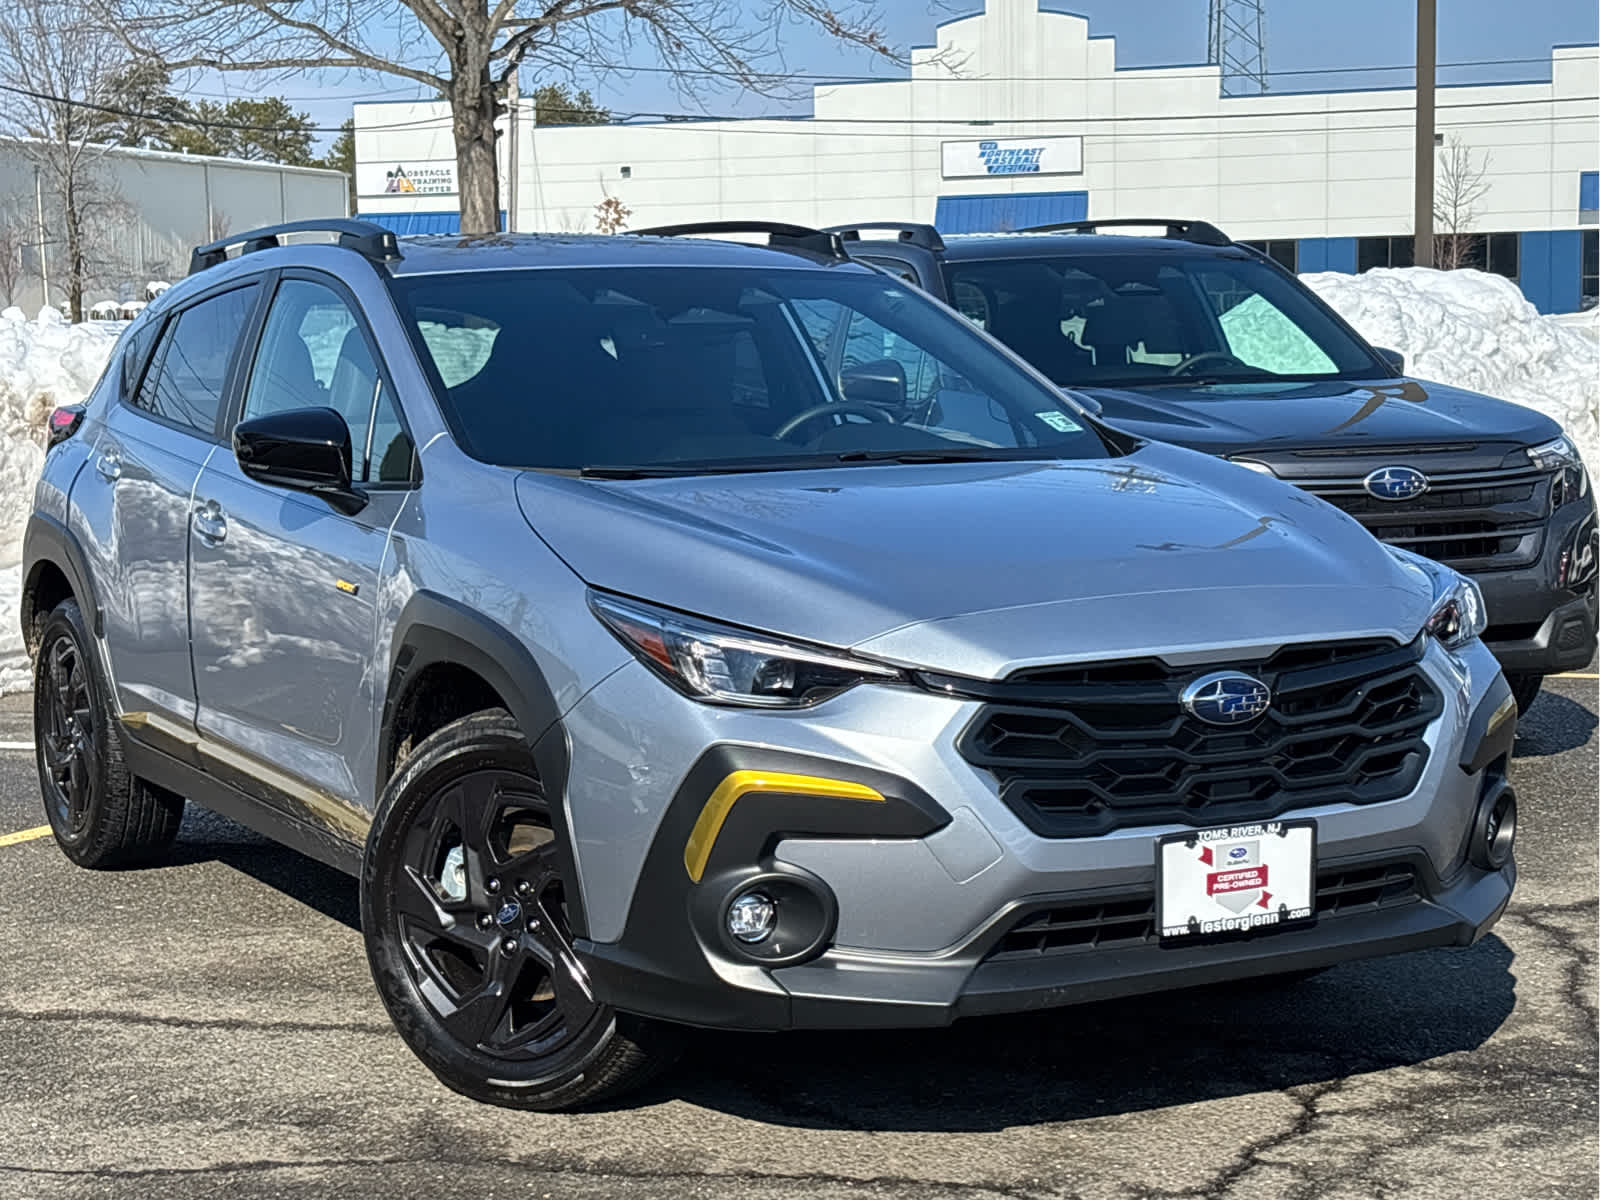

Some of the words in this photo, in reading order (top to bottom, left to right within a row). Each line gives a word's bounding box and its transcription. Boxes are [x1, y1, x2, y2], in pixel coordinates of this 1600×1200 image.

[978, 148, 1046, 158] NORTHEAST
[984, 156, 1041, 165] BASEBALL
[407, 169, 451, 177] OBSTACLE
[1198, 829, 1228, 842] TOMS
[1267, 822, 1282, 834] NJ
[1217, 870, 1259, 882] CERTIFIED
[1213, 878, 1262, 891] PRE-OWNED
